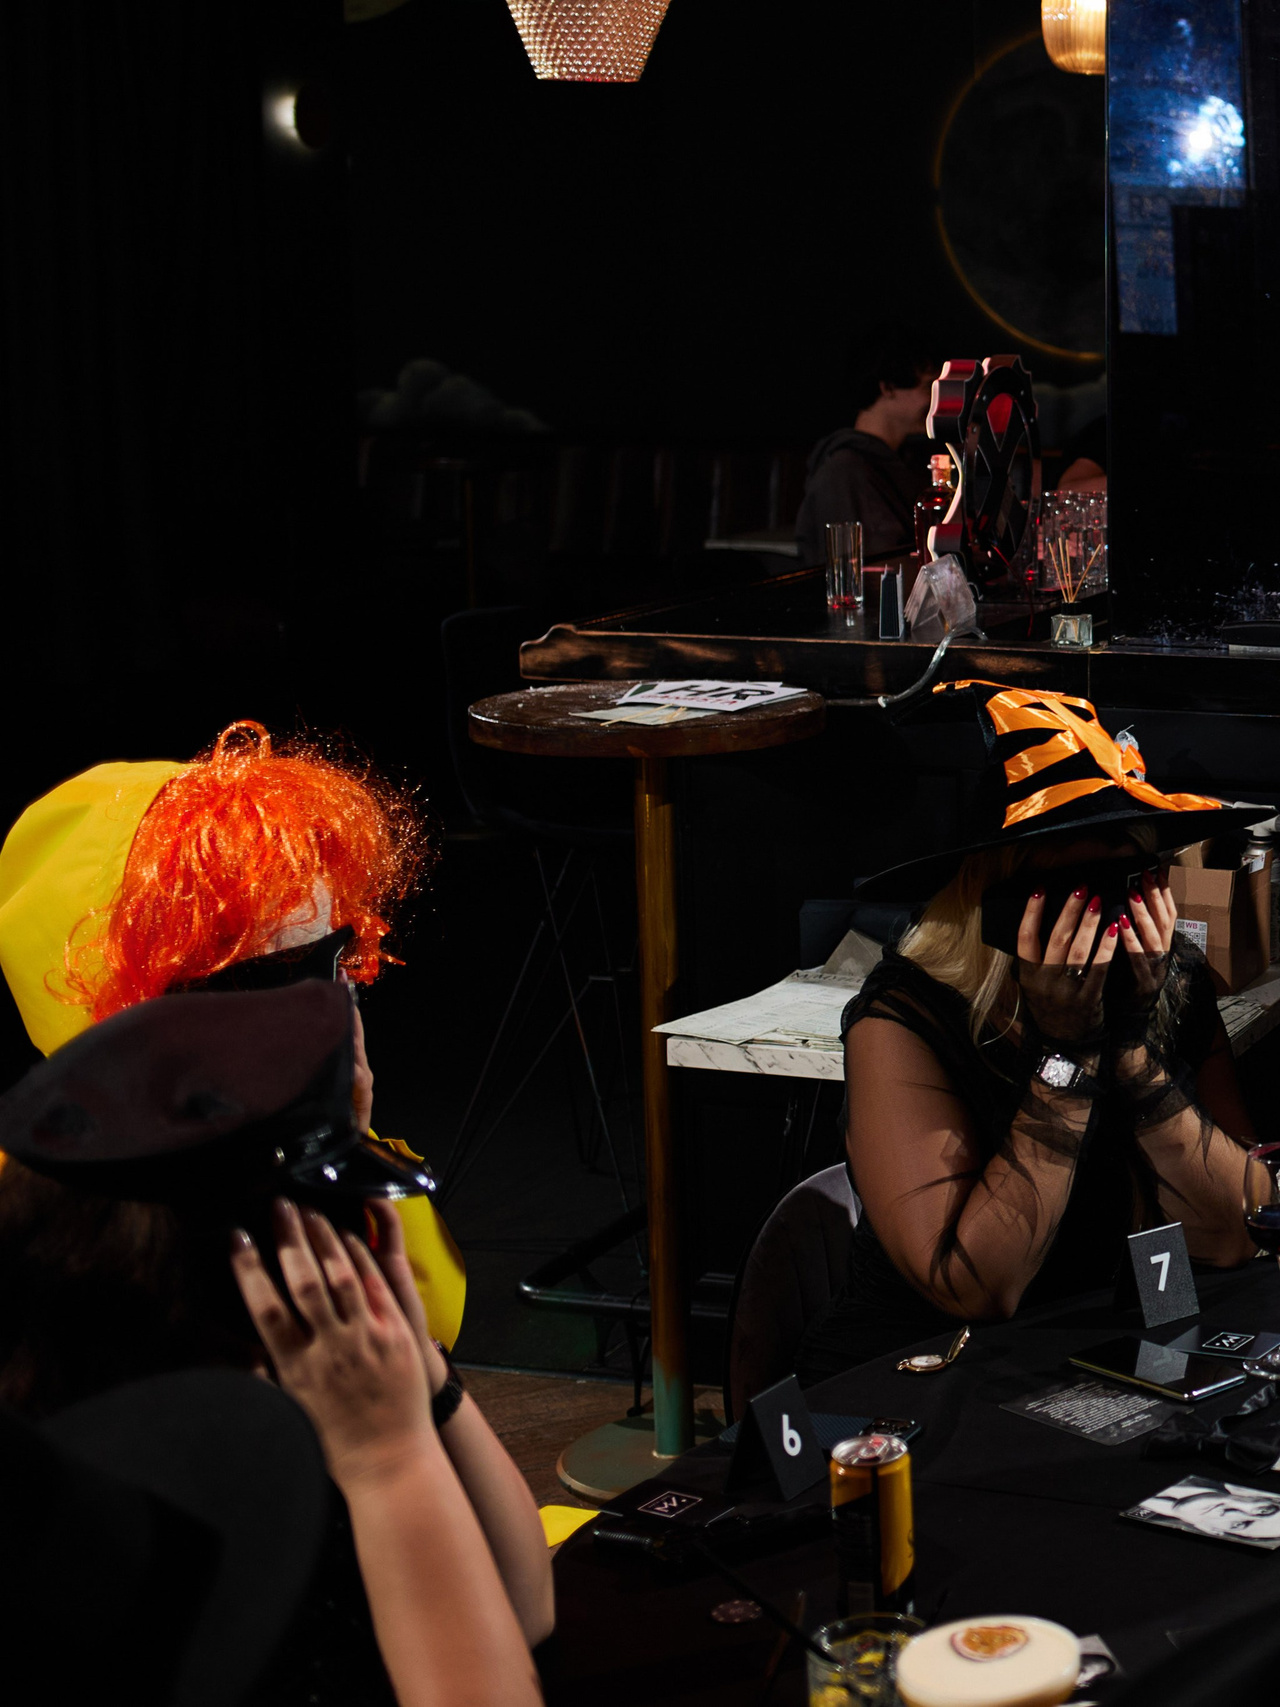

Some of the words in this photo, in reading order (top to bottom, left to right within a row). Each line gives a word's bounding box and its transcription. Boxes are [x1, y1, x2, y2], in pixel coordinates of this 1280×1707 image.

[1185, 921, 1198, 929] WB
[1150, 1252, 1171, 1292] 7
[781, 1413, 802, 1457] 6
